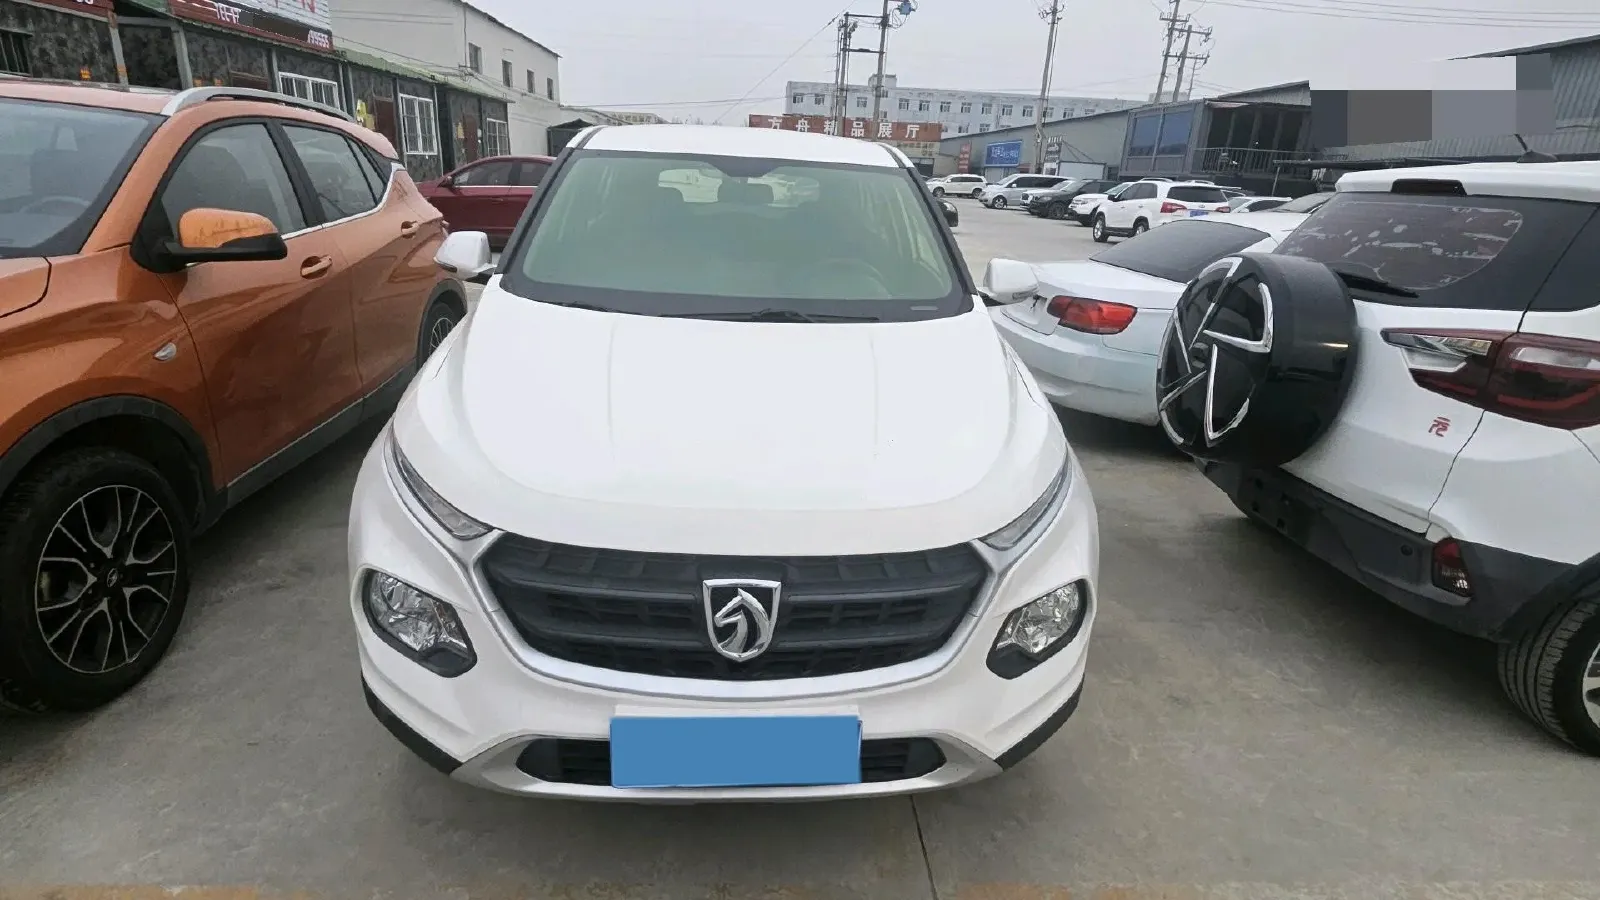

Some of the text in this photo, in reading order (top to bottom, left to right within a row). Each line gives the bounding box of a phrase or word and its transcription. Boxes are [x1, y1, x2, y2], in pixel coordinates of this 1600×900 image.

[768, 117, 920, 138] 方舟精品展厅
